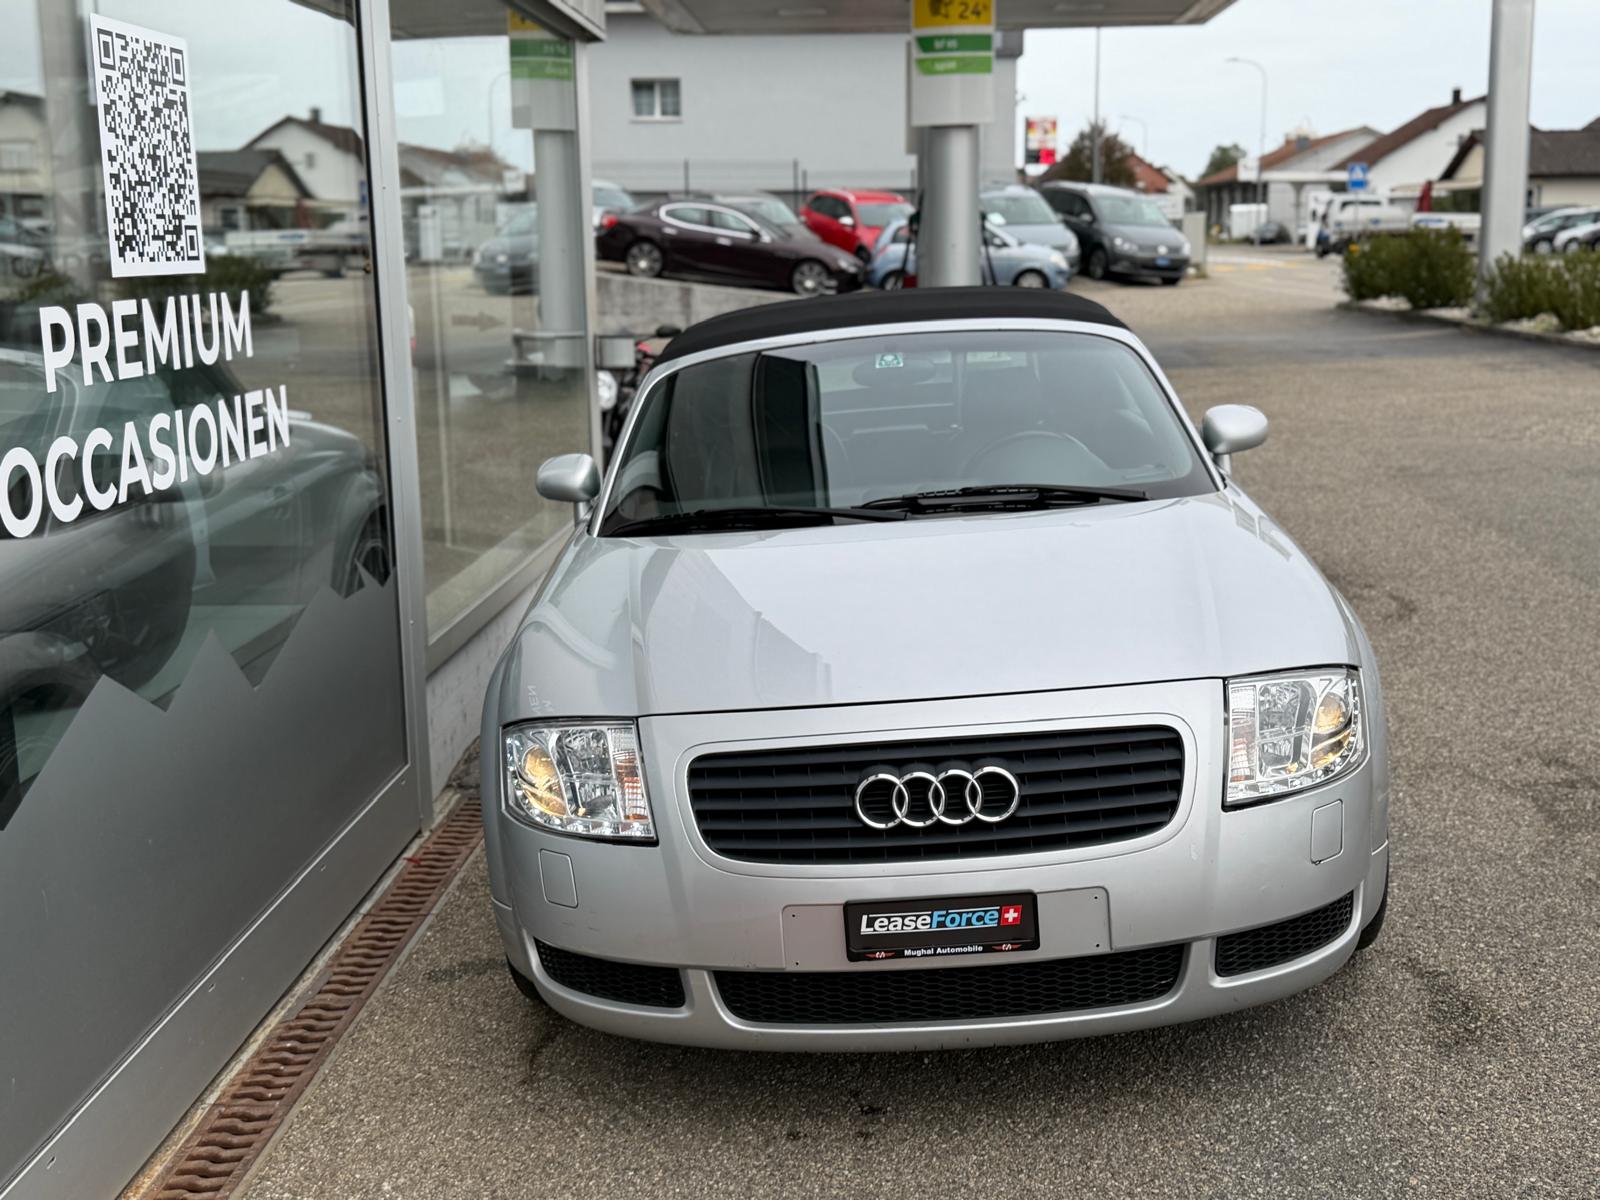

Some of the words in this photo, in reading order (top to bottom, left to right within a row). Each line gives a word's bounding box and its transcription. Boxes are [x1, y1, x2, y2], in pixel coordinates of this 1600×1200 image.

[40, 290, 253, 392] PREMIUM
[0, 385, 290, 537] OCCASIONEN
[860, 908, 999, 933] LeaseForce
[904, 948, 934, 957] Mughal
[936, 945, 983, 954] Automobile
